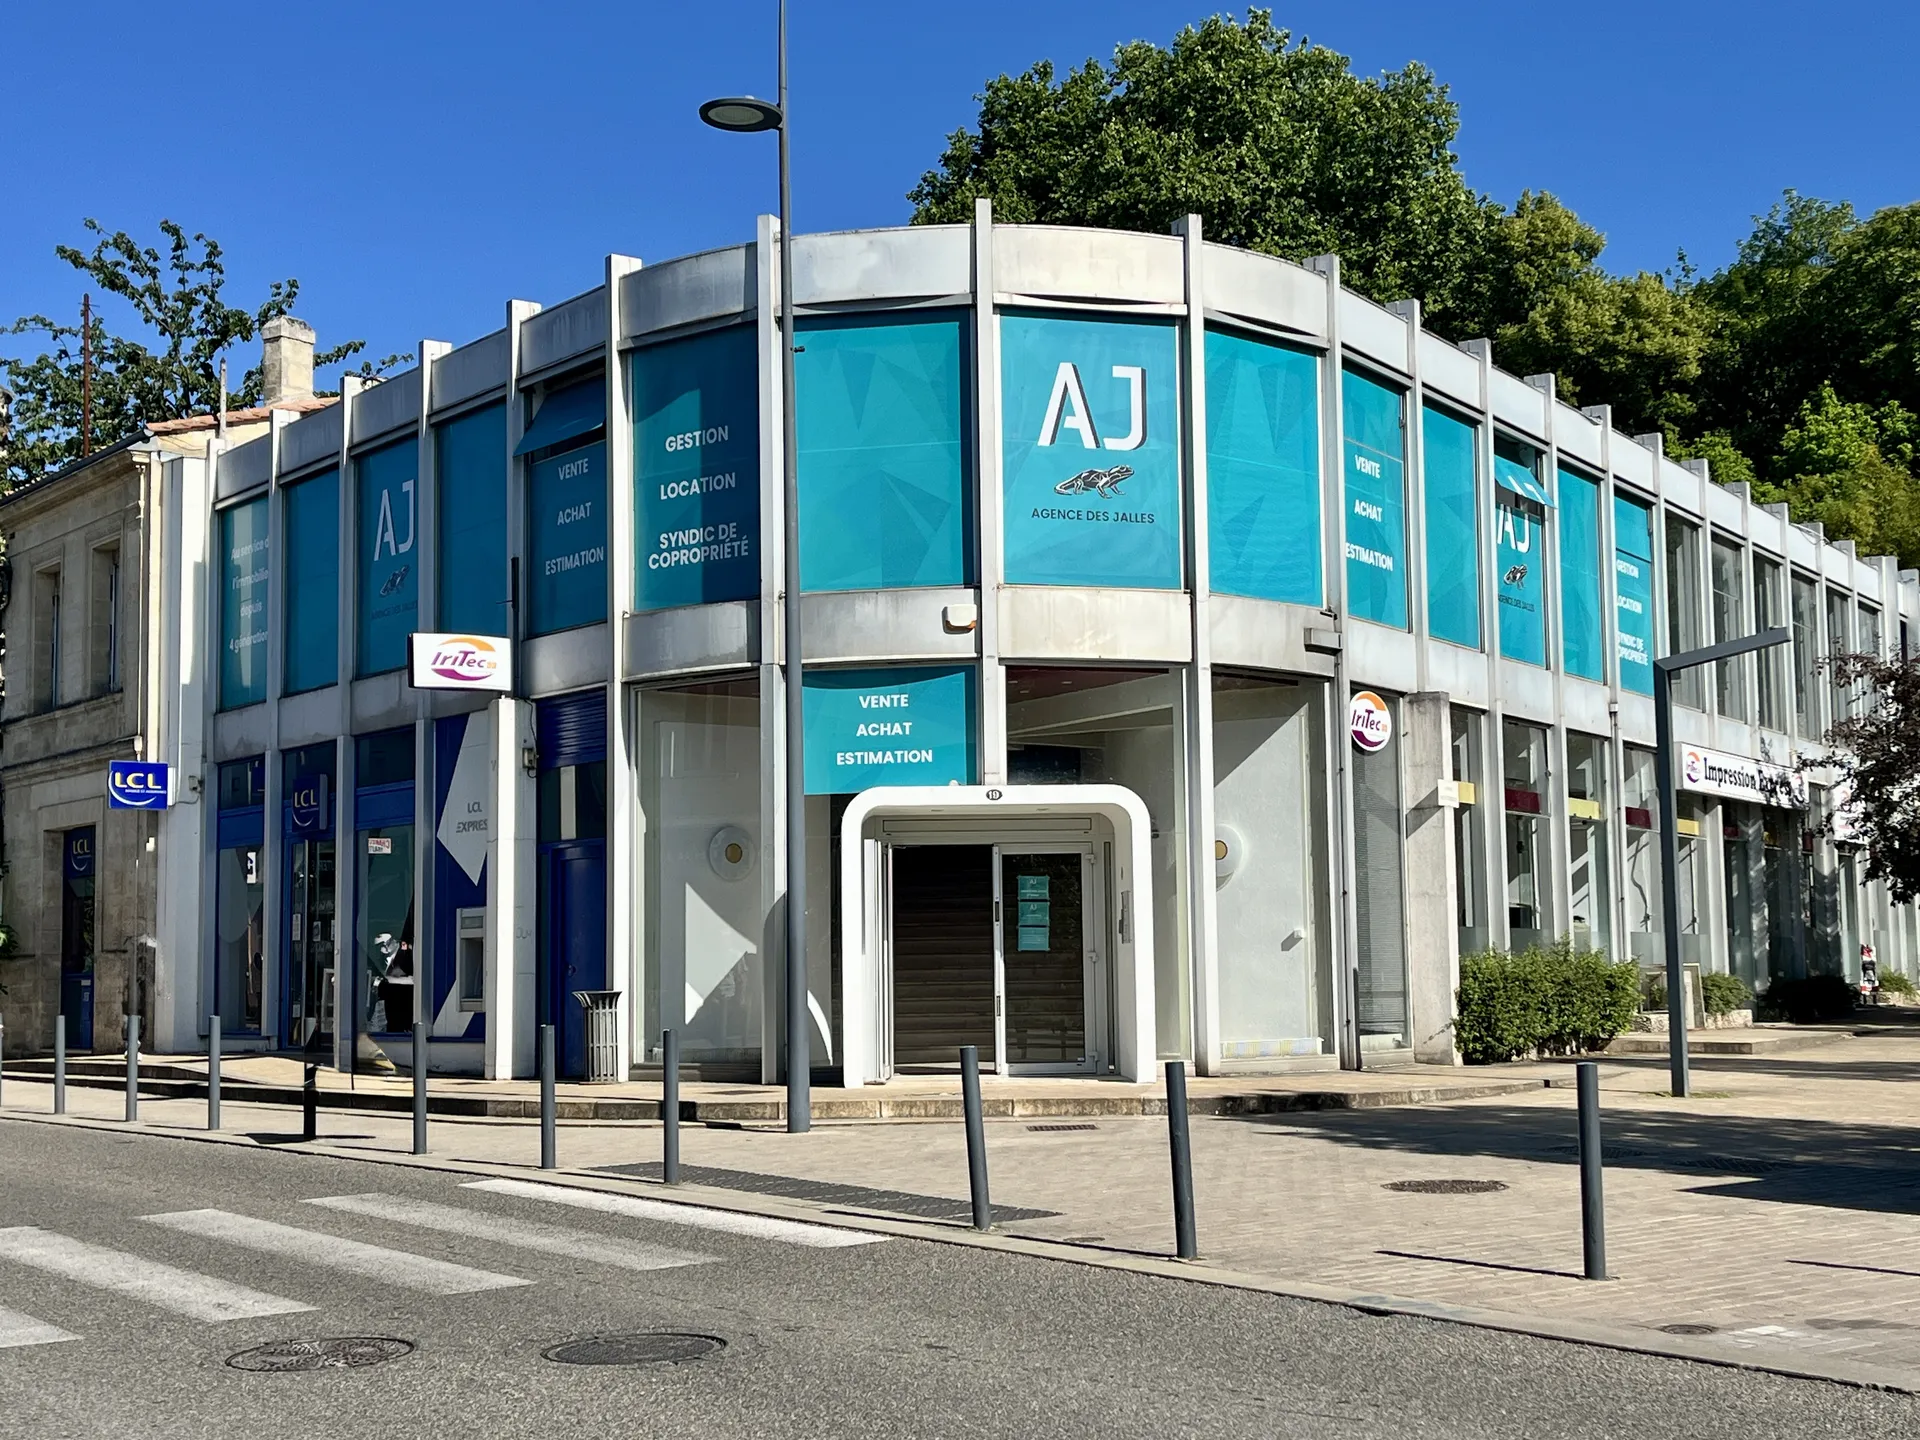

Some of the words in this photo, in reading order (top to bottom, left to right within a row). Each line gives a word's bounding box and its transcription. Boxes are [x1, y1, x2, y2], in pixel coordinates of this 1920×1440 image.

[1037, 362, 1147, 451] AJ
[665, 425, 729, 452] GESTION
[558, 458, 589, 480] VENTE
[1354, 455, 1381, 479] VENTE
[660, 472, 736, 500] LOCATION
[374, 479, 414, 561] AJ
[557, 502, 592, 525] ACHAT
[1031, 508, 1083, 521] AGENCE
[1086, 511, 1109, 522] DES
[1113, 512, 1155, 524] JALLES
[1354, 500, 1383, 522] ACHAT
[659, 526, 715, 549] SYNDIC
[718, 523, 737, 542] DE
[545, 546, 604, 576] ESTIMATION
[648, 535, 749, 569] COPROPRIÉTÉ
[1345, 542, 1394, 572] ESTIMATION
[1617, 595, 1642, 615] OCATION
[431, 650, 487, 668] IriTec
[859, 694, 909, 709] VENTE
[856, 722, 912, 736] ACHAT
[1352, 709, 1381, 731] IriTec
[836, 749, 933, 765] ESTIMATION
[115, 772, 162, 789] LCL
[1703, 757, 1757, 790] Impression
[294, 789, 317, 808] LCL
[467, 801, 482, 814] LCL
[73, 839, 90, 854] LCL
